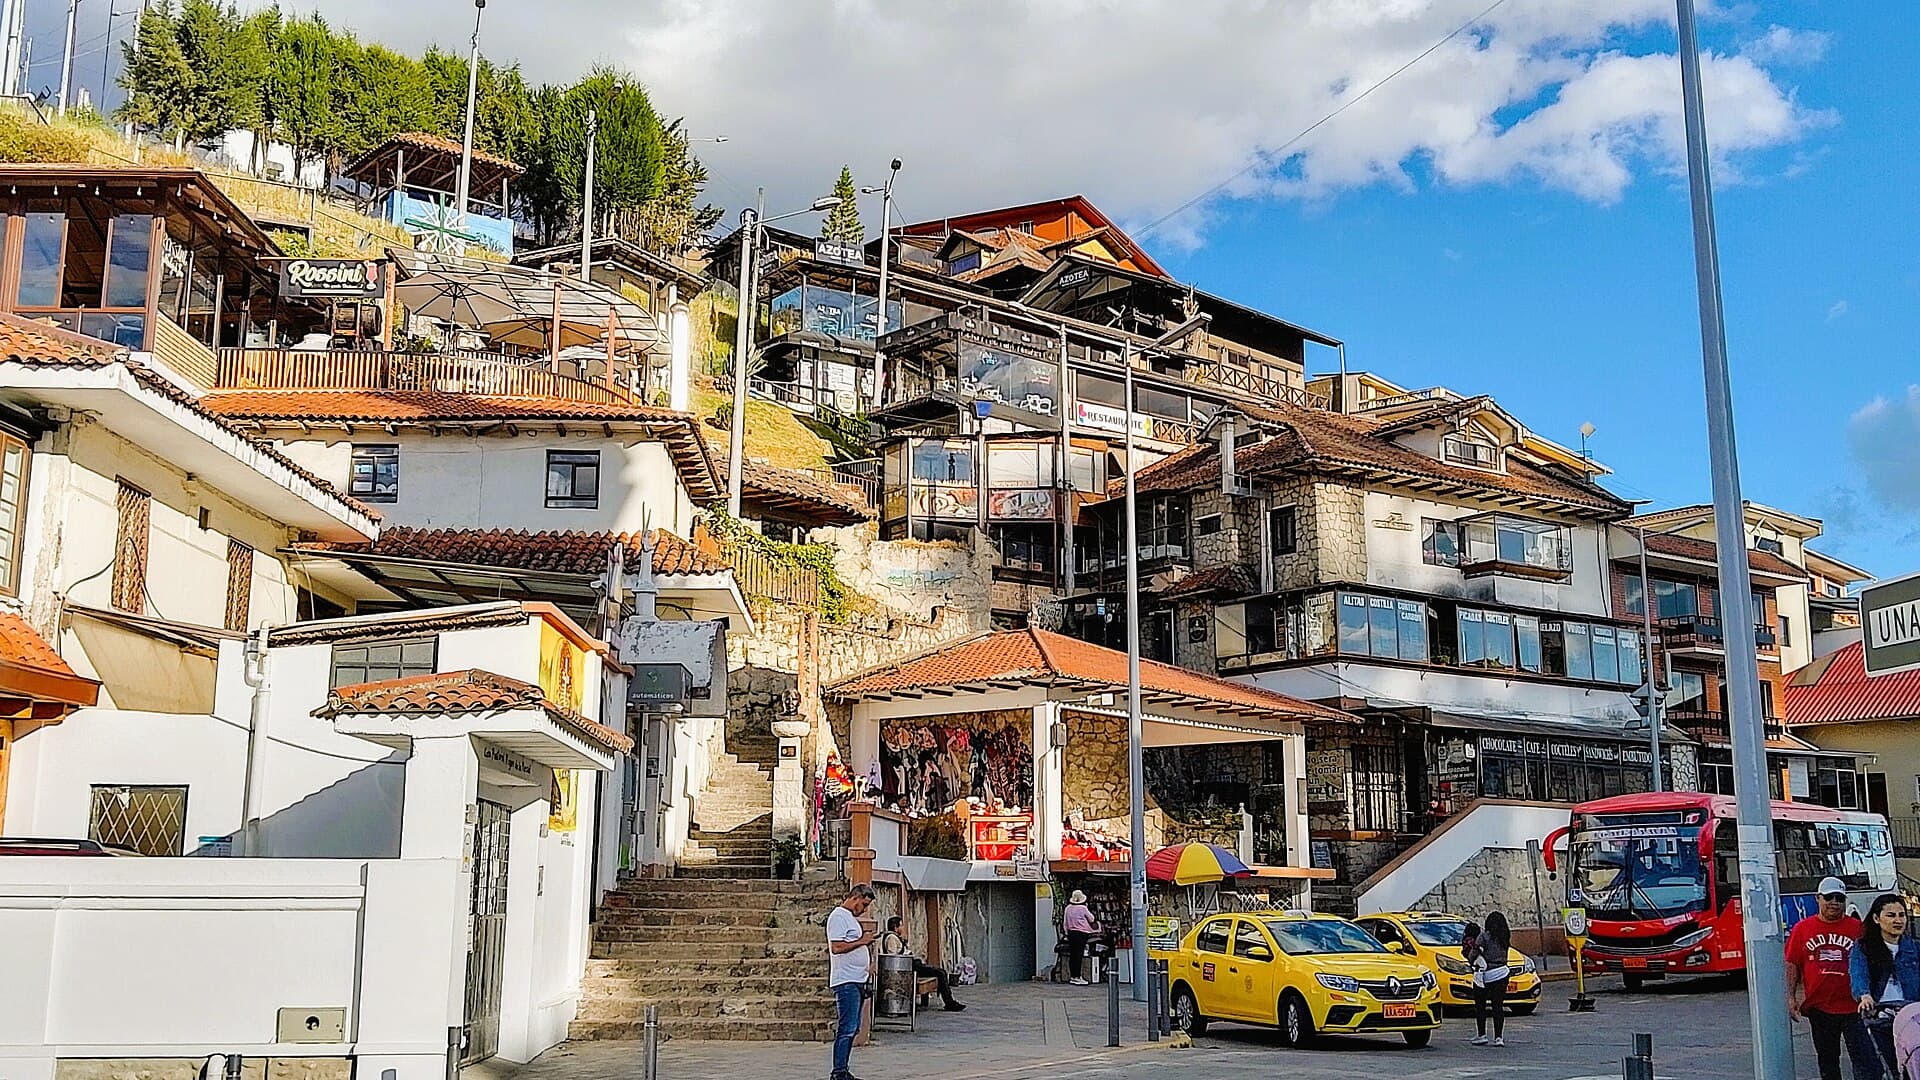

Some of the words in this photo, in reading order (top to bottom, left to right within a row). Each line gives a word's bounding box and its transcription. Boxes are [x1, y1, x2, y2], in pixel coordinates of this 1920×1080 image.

[817, 243, 863, 261] AZOTEA
[287, 260, 363, 288] Rossini
[1059, 269, 1089, 285] AZOTEA
[1369, 597, 1394, 610] COSTILLA
[1878, 604, 1920, 643] UNA
[1482, 737, 1517, 753] CHOCOLATE
[1622, 749, 1653, 763] EMBUTIDO
[1805, 933, 1826, 952] OLD
[1828, 933, 1854, 952] NAVY
